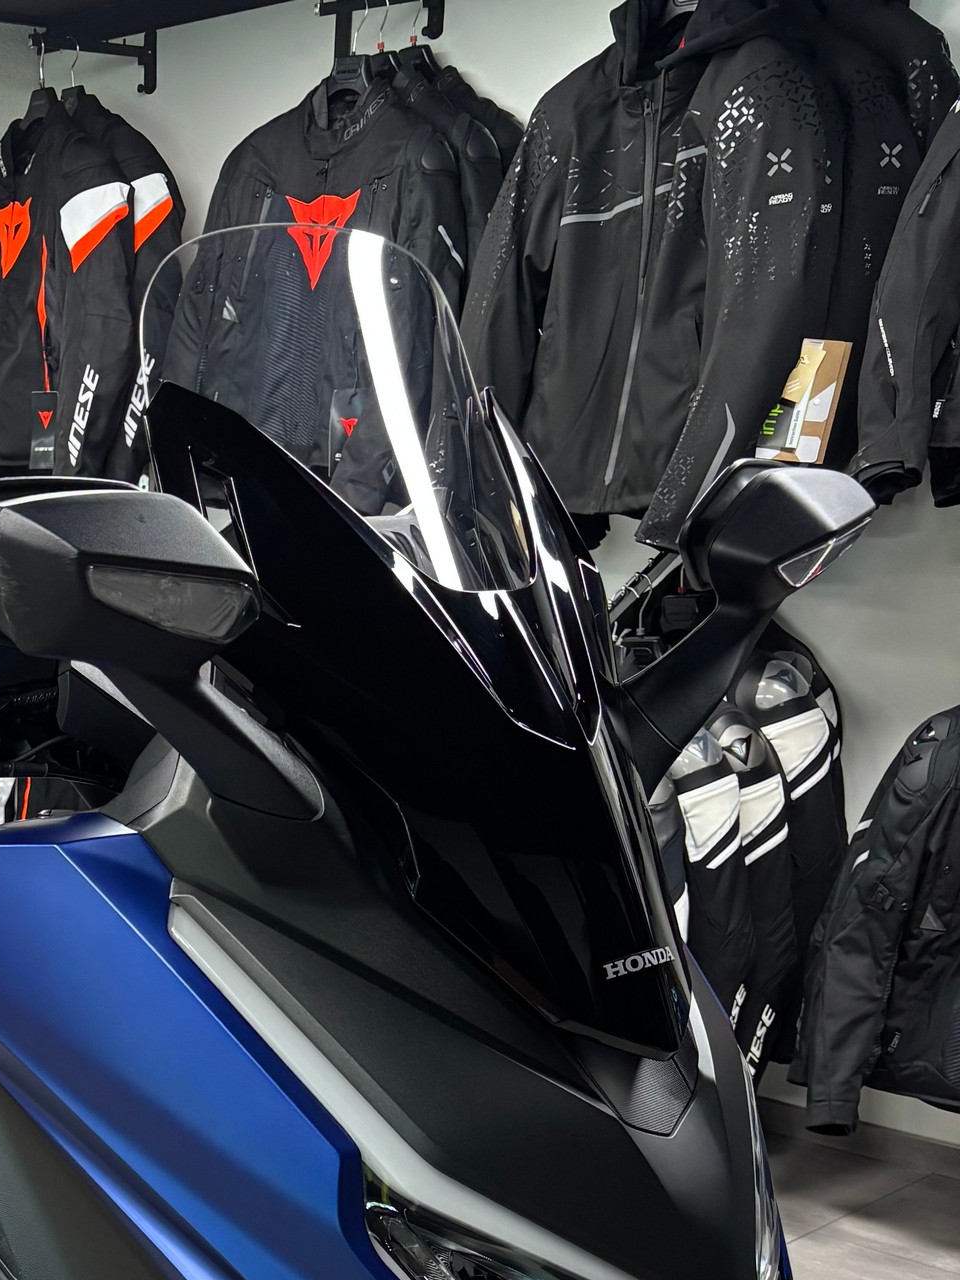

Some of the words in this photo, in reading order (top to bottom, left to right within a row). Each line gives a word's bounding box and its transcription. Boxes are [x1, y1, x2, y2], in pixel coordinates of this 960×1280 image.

[768, 196, 793, 206] READY
[770, 192, 794, 201] AIRBAG
[603, 946, 675, 980] HONDA
